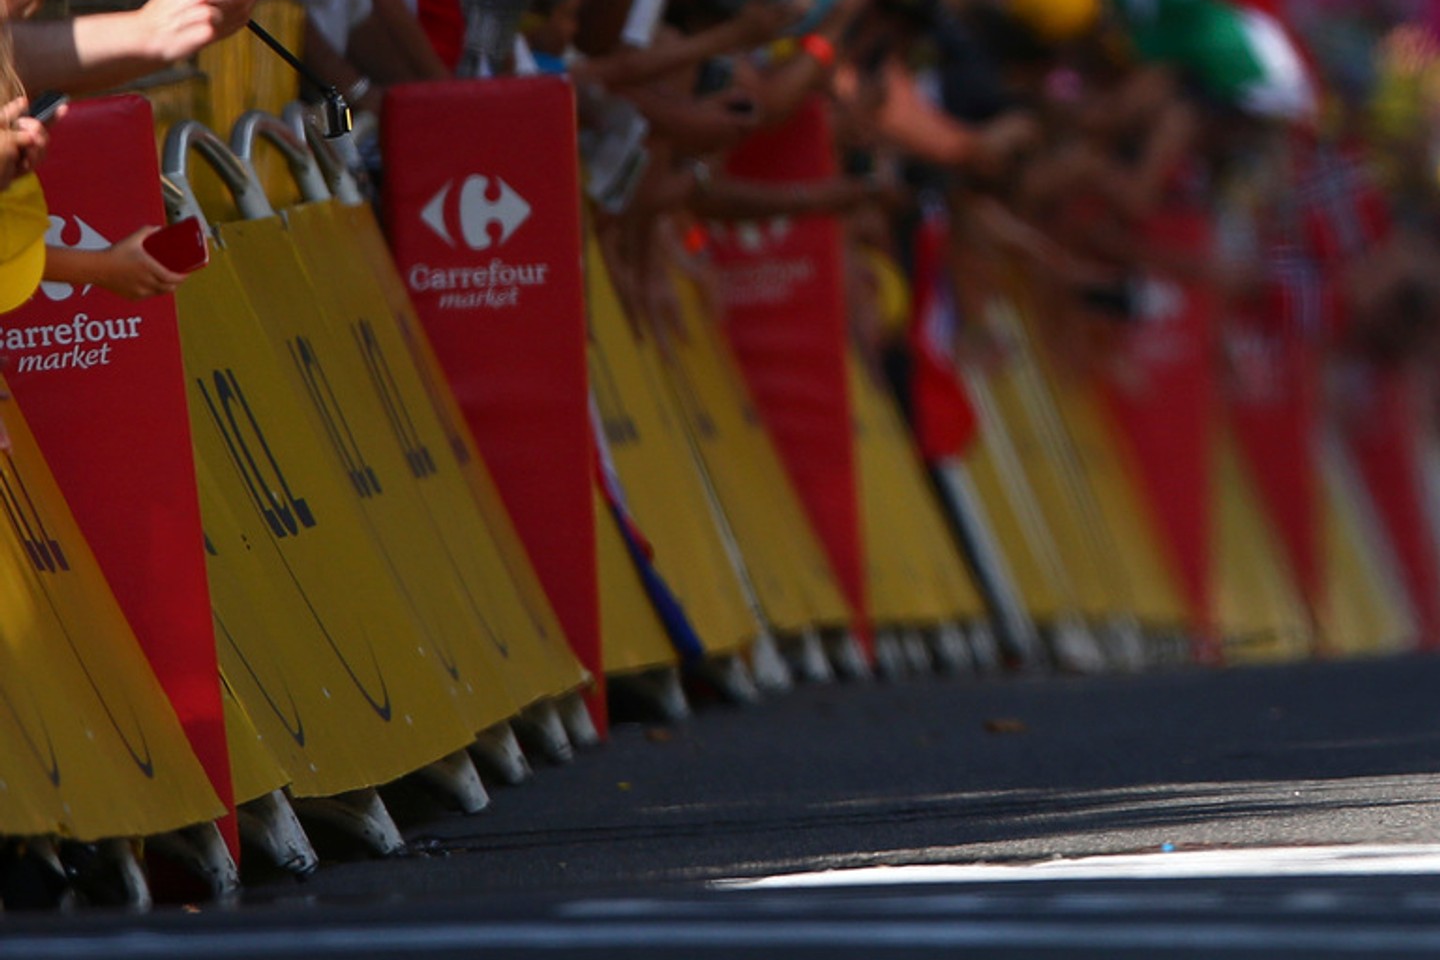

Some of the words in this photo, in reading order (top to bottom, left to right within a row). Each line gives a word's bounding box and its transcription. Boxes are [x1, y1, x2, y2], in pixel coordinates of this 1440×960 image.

[409, 257, 549, 291] Carrefour
[438, 287, 520, 310] market
[18, 342, 112, 373] market
